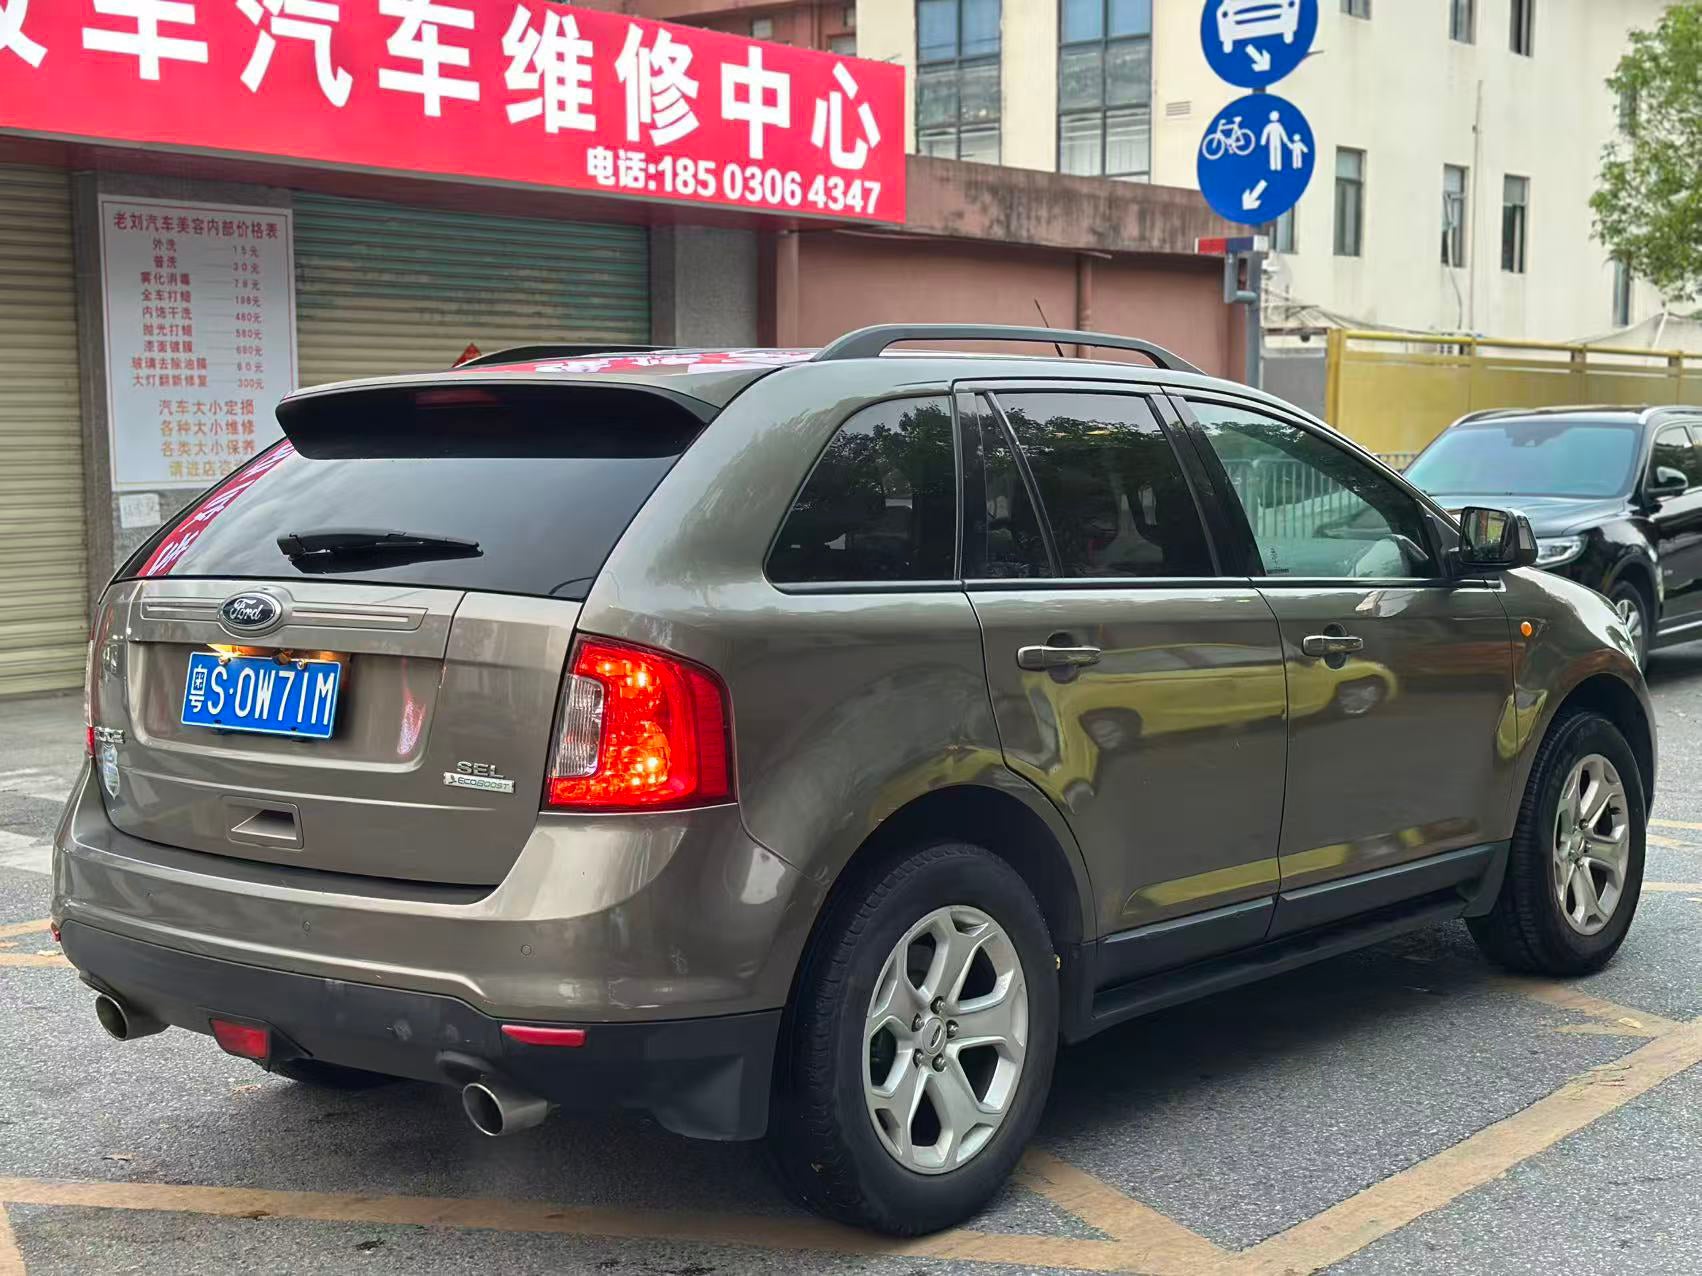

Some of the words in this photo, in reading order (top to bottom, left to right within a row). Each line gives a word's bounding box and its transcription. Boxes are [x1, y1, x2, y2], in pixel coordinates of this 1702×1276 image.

[723, 163, 802, 207] 0306
[807, 174, 881, 214] 4347
[114, 212, 280, 239] 老刘汽车美容内部价格表
[153, 238, 177, 252] 外洗
[159, 400, 254, 416] 汽车大小定损
[161, 419, 256, 436] 各种大小维修
[161, 440, 257, 457] 各类大小保养
[230, 598, 264, 620] Ford
[457, 761, 504, 778] SEL
